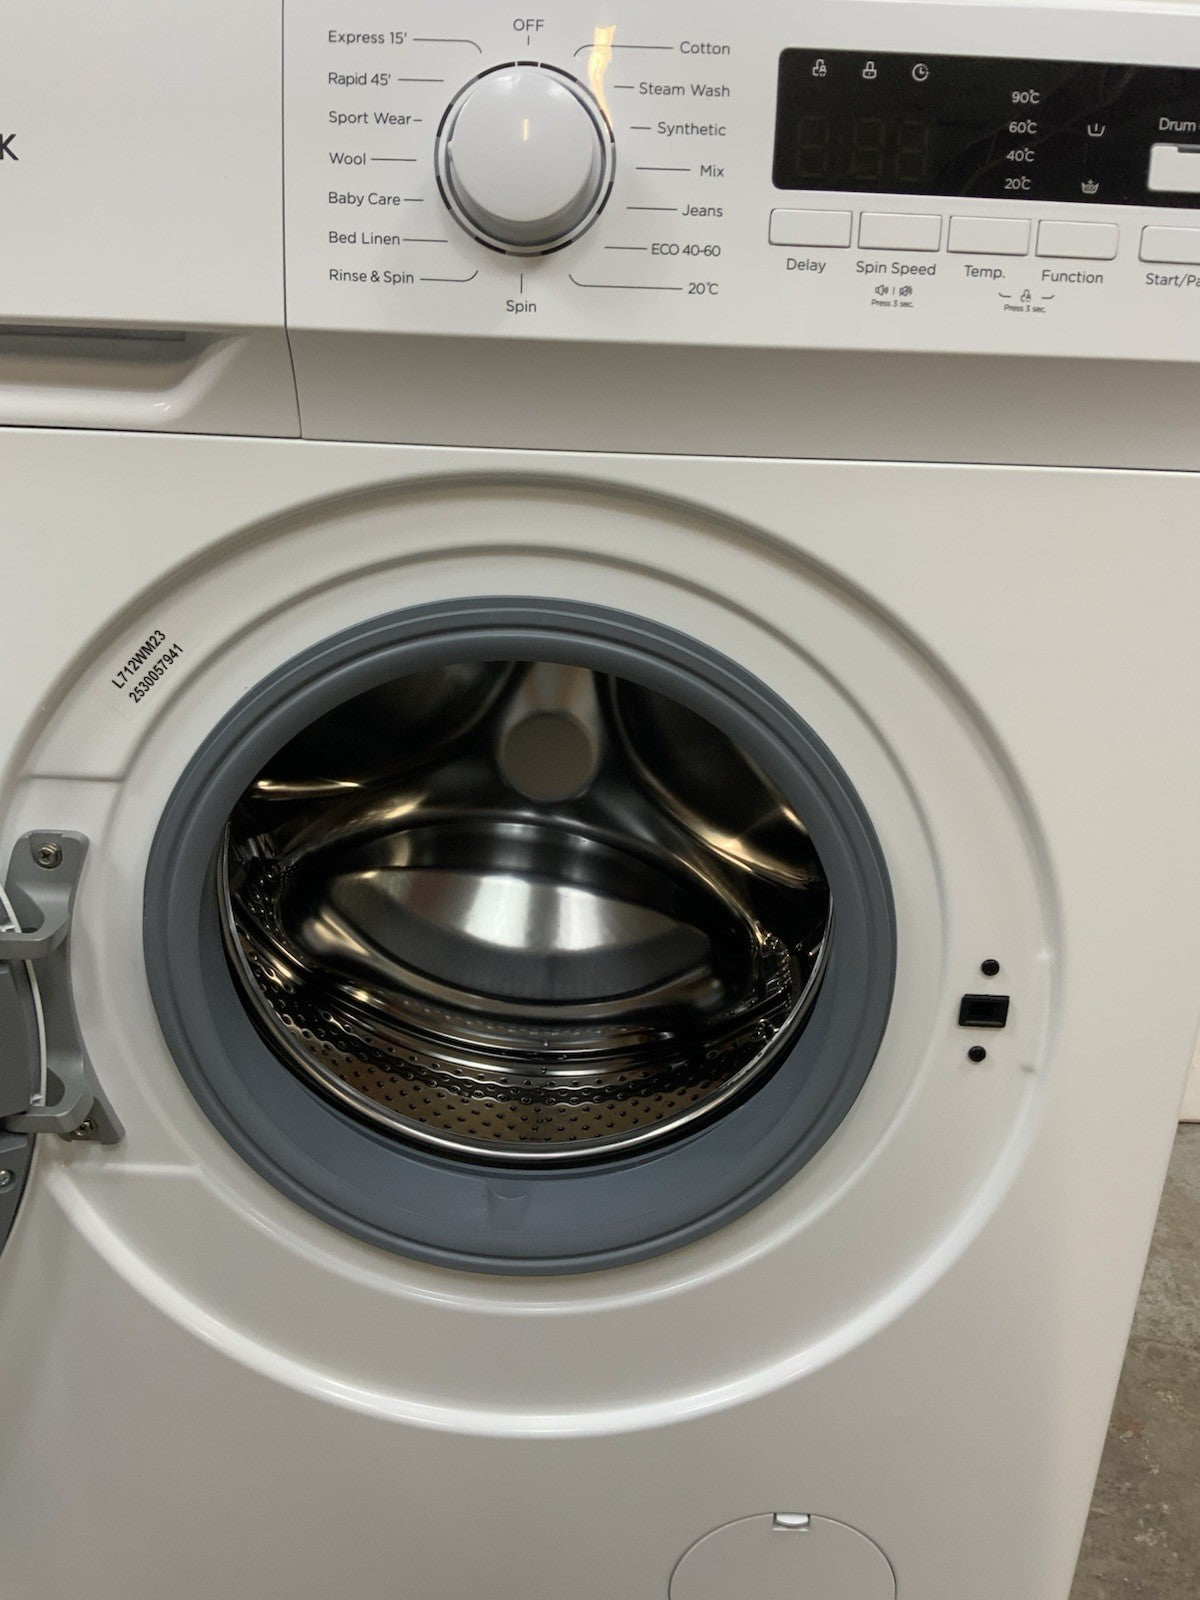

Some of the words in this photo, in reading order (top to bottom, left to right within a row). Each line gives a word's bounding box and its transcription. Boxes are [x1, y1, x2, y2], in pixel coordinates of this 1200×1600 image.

[513, 19, 545, 31] OFF
[328, 31, 385, 45] Express
[680, 42, 730, 55] Cotton
[328, 72, 367, 86] Rapid
[639, 82, 685, 96] Steam
[690, 84, 730, 98] Wash
[329, 111, 369, 125] Sport
[374, 112, 411, 125] Wear
[1158, 117, 1196, 132] Drum
[657, 122, 726, 137] Synthetic
[329, 152, 366, 165] Wool
[700, 165, 724, 178] Mix
[328, 192, 364, 206] Baby
[368, 193, 401, 206] Care
[682, 205, 723, 218] Jeans
[329, 231, 356, 244] Bed
[362, 233, 400, 245] Linen
[651, 243, 680, 256] ECO
[682, 244, 721, 257] 40-60
[786, 258, 827, 274] Delay
[855, 261, 888, 276] Spin
[891, 262, 937, 277] Speed
[964, 265, 1006, 279] Temp.
[329, 269, 367, 283] Rinse
[370, 271, 381, 283] &
[383, 271, 414, 285] Spin
[1041, 270, 1104, 284] Function
[506, 300, 537, 314] Spin
[871, 299, 891, 308] Press
[1003, 304, 1024, 313] Press
[1025, 305, 1030, 313] 3
[111, 630, 166, 689] L712WM23
[129, 643, 184, 704] 2530057941
